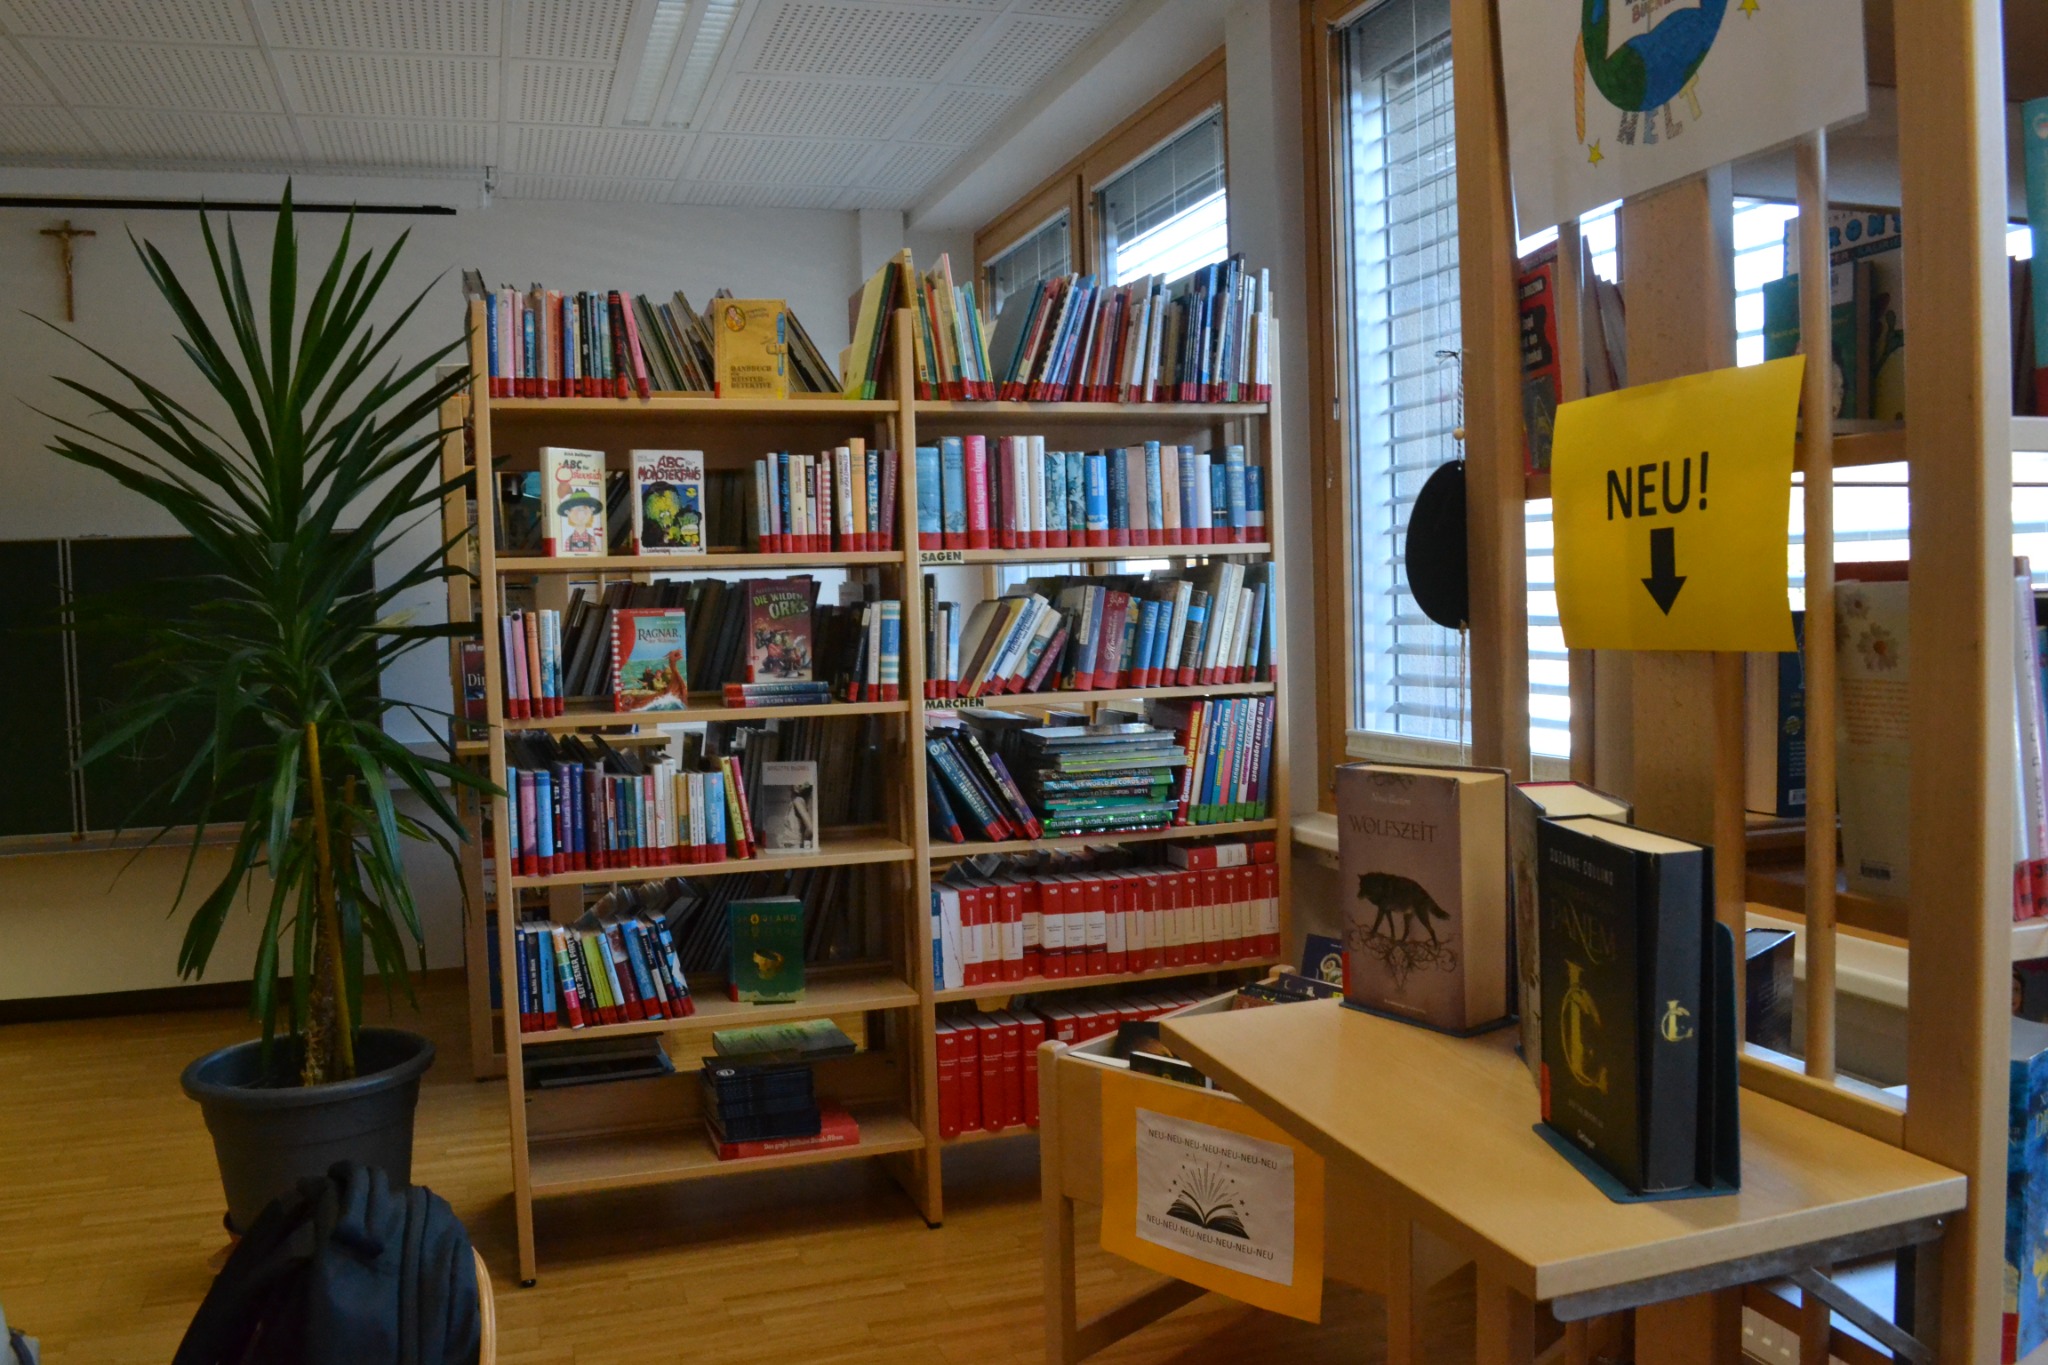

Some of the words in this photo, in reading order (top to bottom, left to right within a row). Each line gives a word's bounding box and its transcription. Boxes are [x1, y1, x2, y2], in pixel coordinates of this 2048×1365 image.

[563, 459, 582, 469] ABC
[657, 455, 685, 468] ABC
[868, 454, 878, 475] PAN
[869, 479, 878, 515] PETER
[1606, 451, 1709, 521] NEU!
[921, 551, 962, 562] SAGEN
[753, 595, 768, 606] DIE
[768, 600, 810, 620] ORKS
[1255, 716, 1263, 740] grosse
[1251, 741, 1261, 783] Jugendbuch
[1052, 782, 1085, 790] GUINNESS
[1085, 780, 1109, 788] WORLD
[1110, 778, 1140, 787] RECORDS
[1180, 768, 1193, 803] GUINNESS
[1085, 818, 1109, 826] WORLD
[1349, 814, 1438, 843] WOLFSZEIT
[1549, 847, 1581, 872] SUZANNE
[1582, 860, 1614, 886] COLLINS
[571, 957, 583, 982] JENER
[577, 982, 587, 999] SEIT
[1148, 1128, 1278, 1171] NEU-NEU-NEU-NEU-NEU-NEU-NEU
